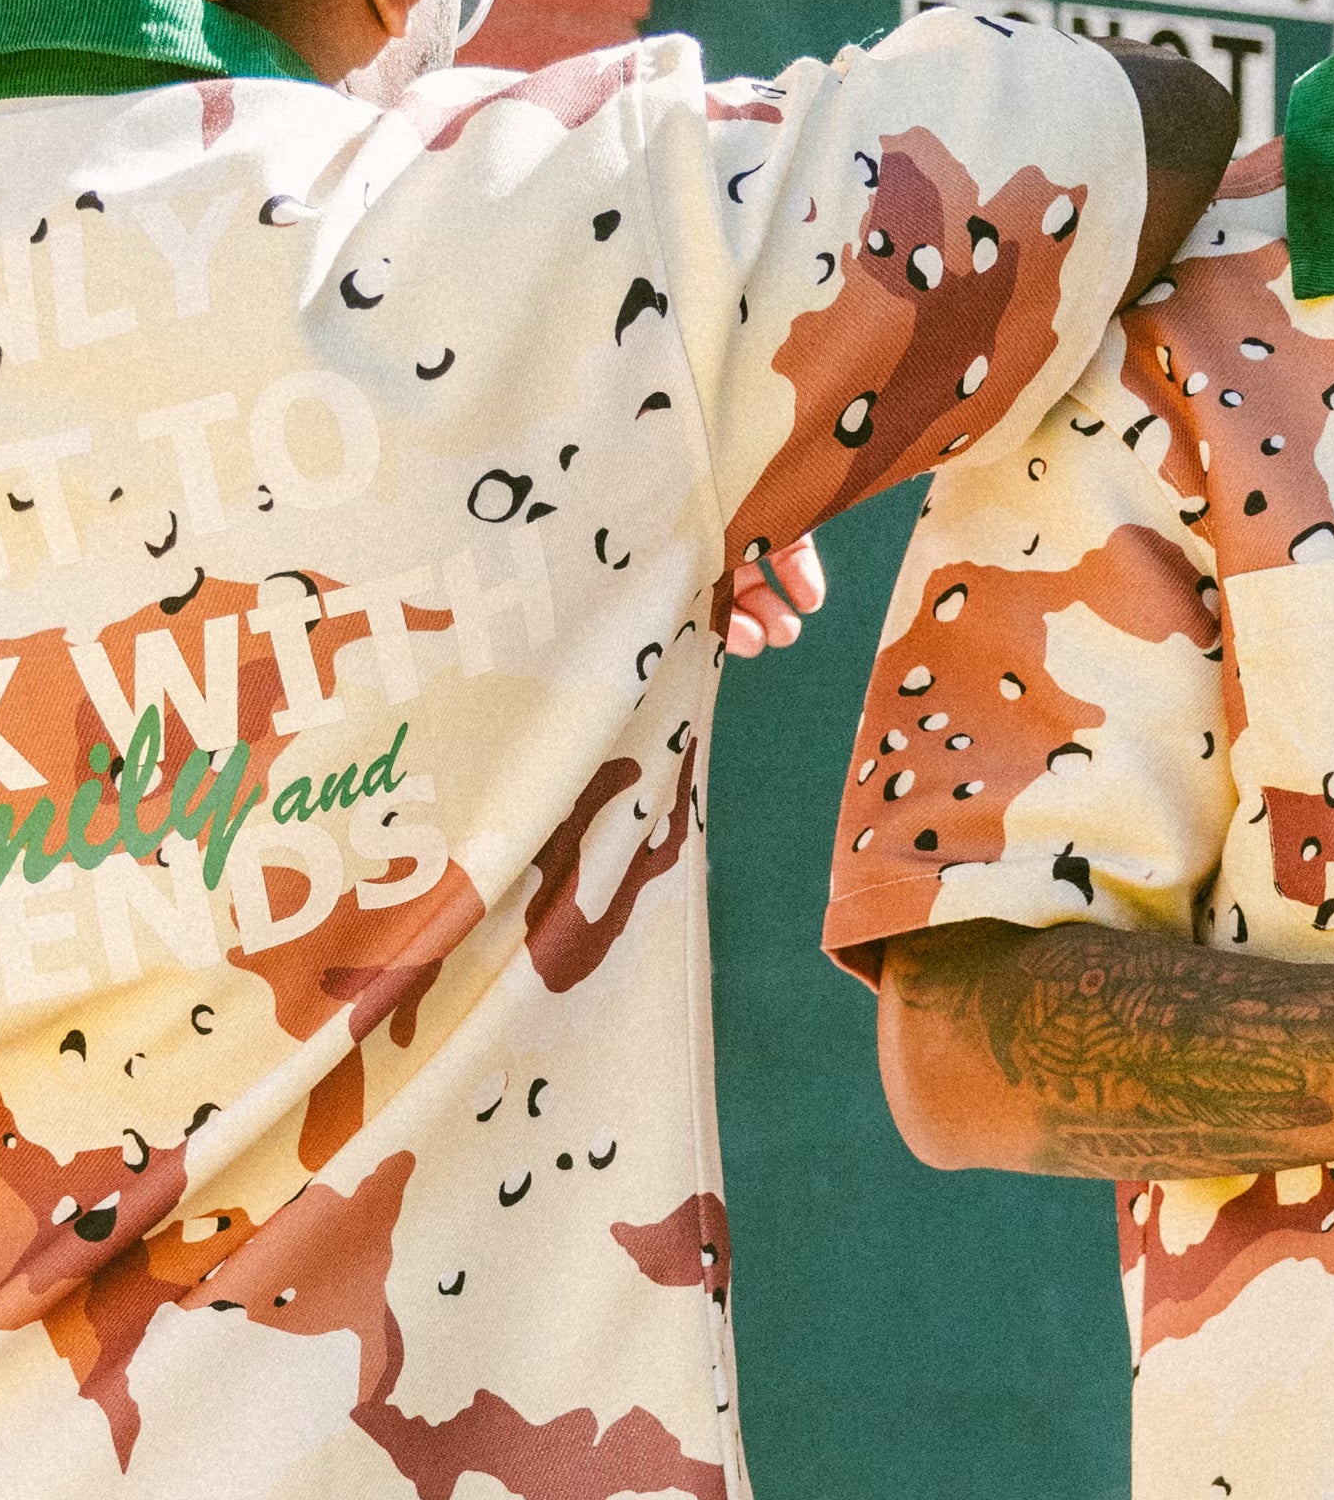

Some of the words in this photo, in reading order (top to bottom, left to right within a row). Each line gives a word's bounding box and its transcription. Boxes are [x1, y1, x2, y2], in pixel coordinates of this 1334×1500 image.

[139, 368, 383, 540] TO
[70, 530, 560, 763] WITH
[271, 722, 410, 827] and
